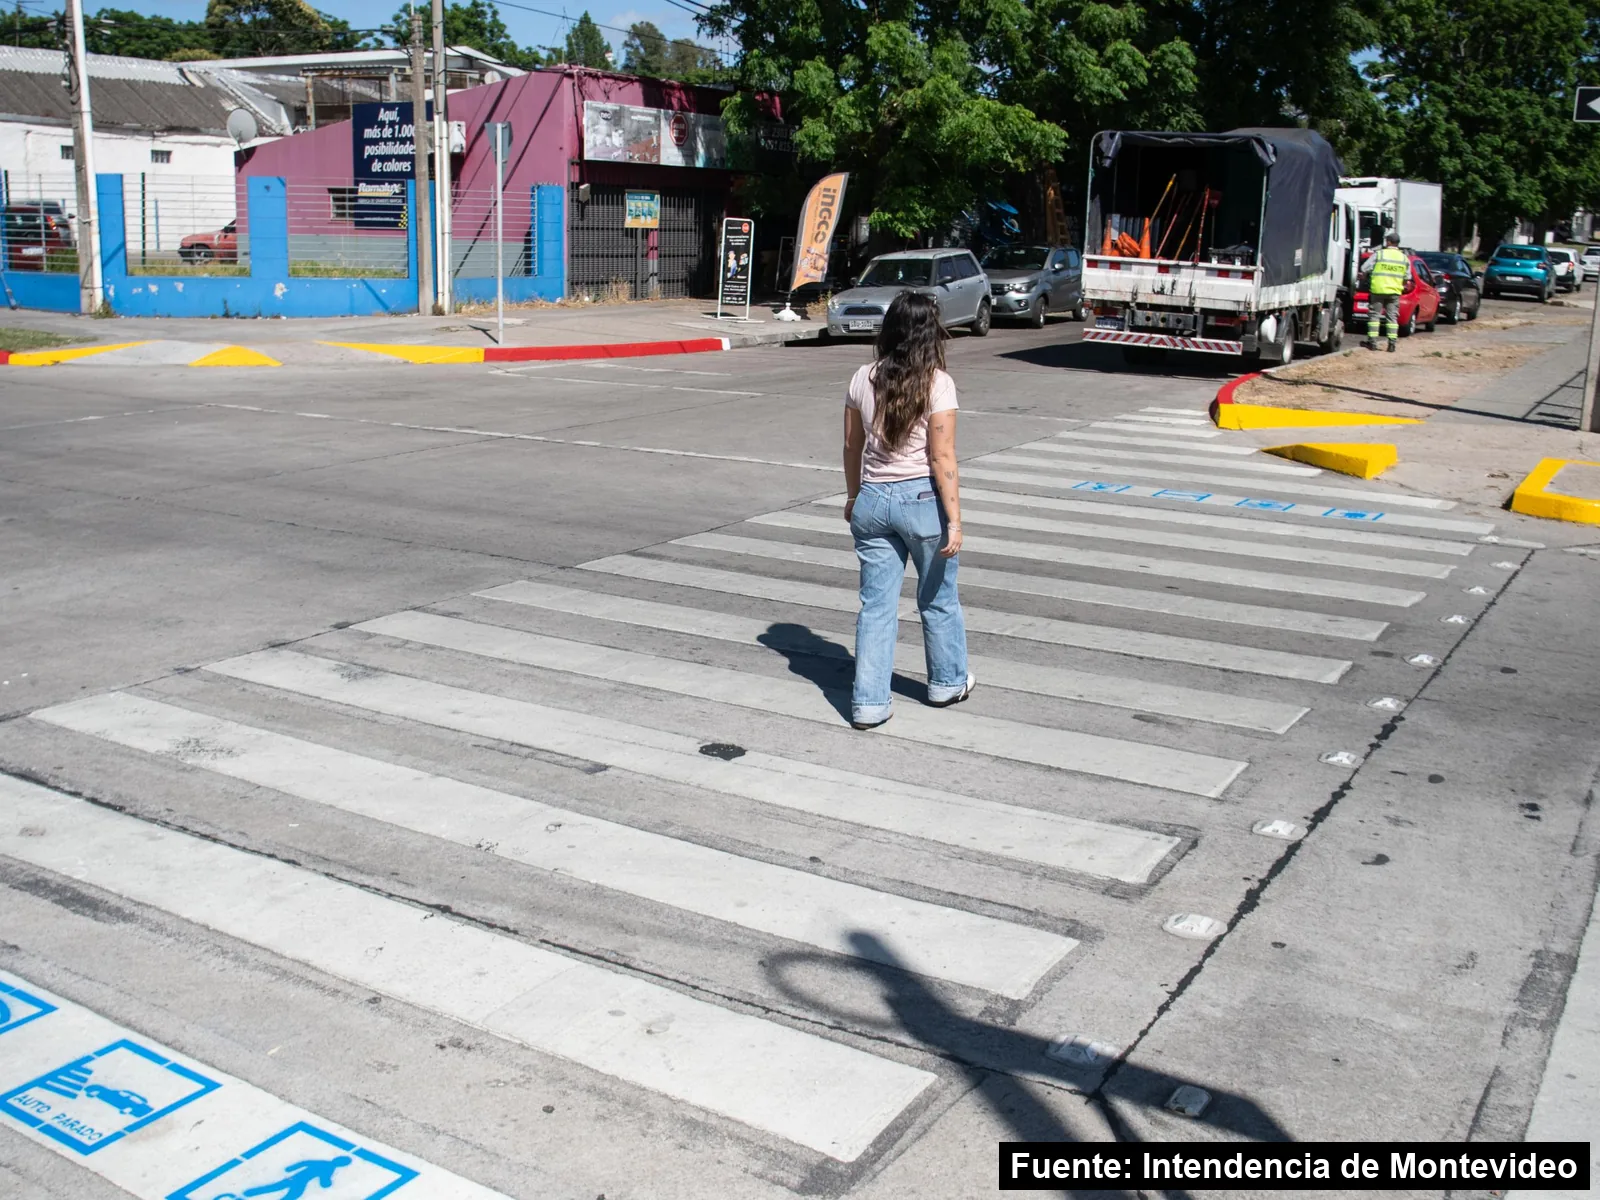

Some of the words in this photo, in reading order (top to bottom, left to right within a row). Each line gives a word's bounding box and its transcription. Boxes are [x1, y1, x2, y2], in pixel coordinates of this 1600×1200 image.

[378, 106, 400, 123] Aquí,
[364, 124, 381, 138] más
[382, 125, 393, 138] de
[371, 159, 381, 172] de
[382, 158, 412, 172] colores
[13, 1094, 52, 1114] AUTO
[51, 1113, 104, 1140] PARADO
